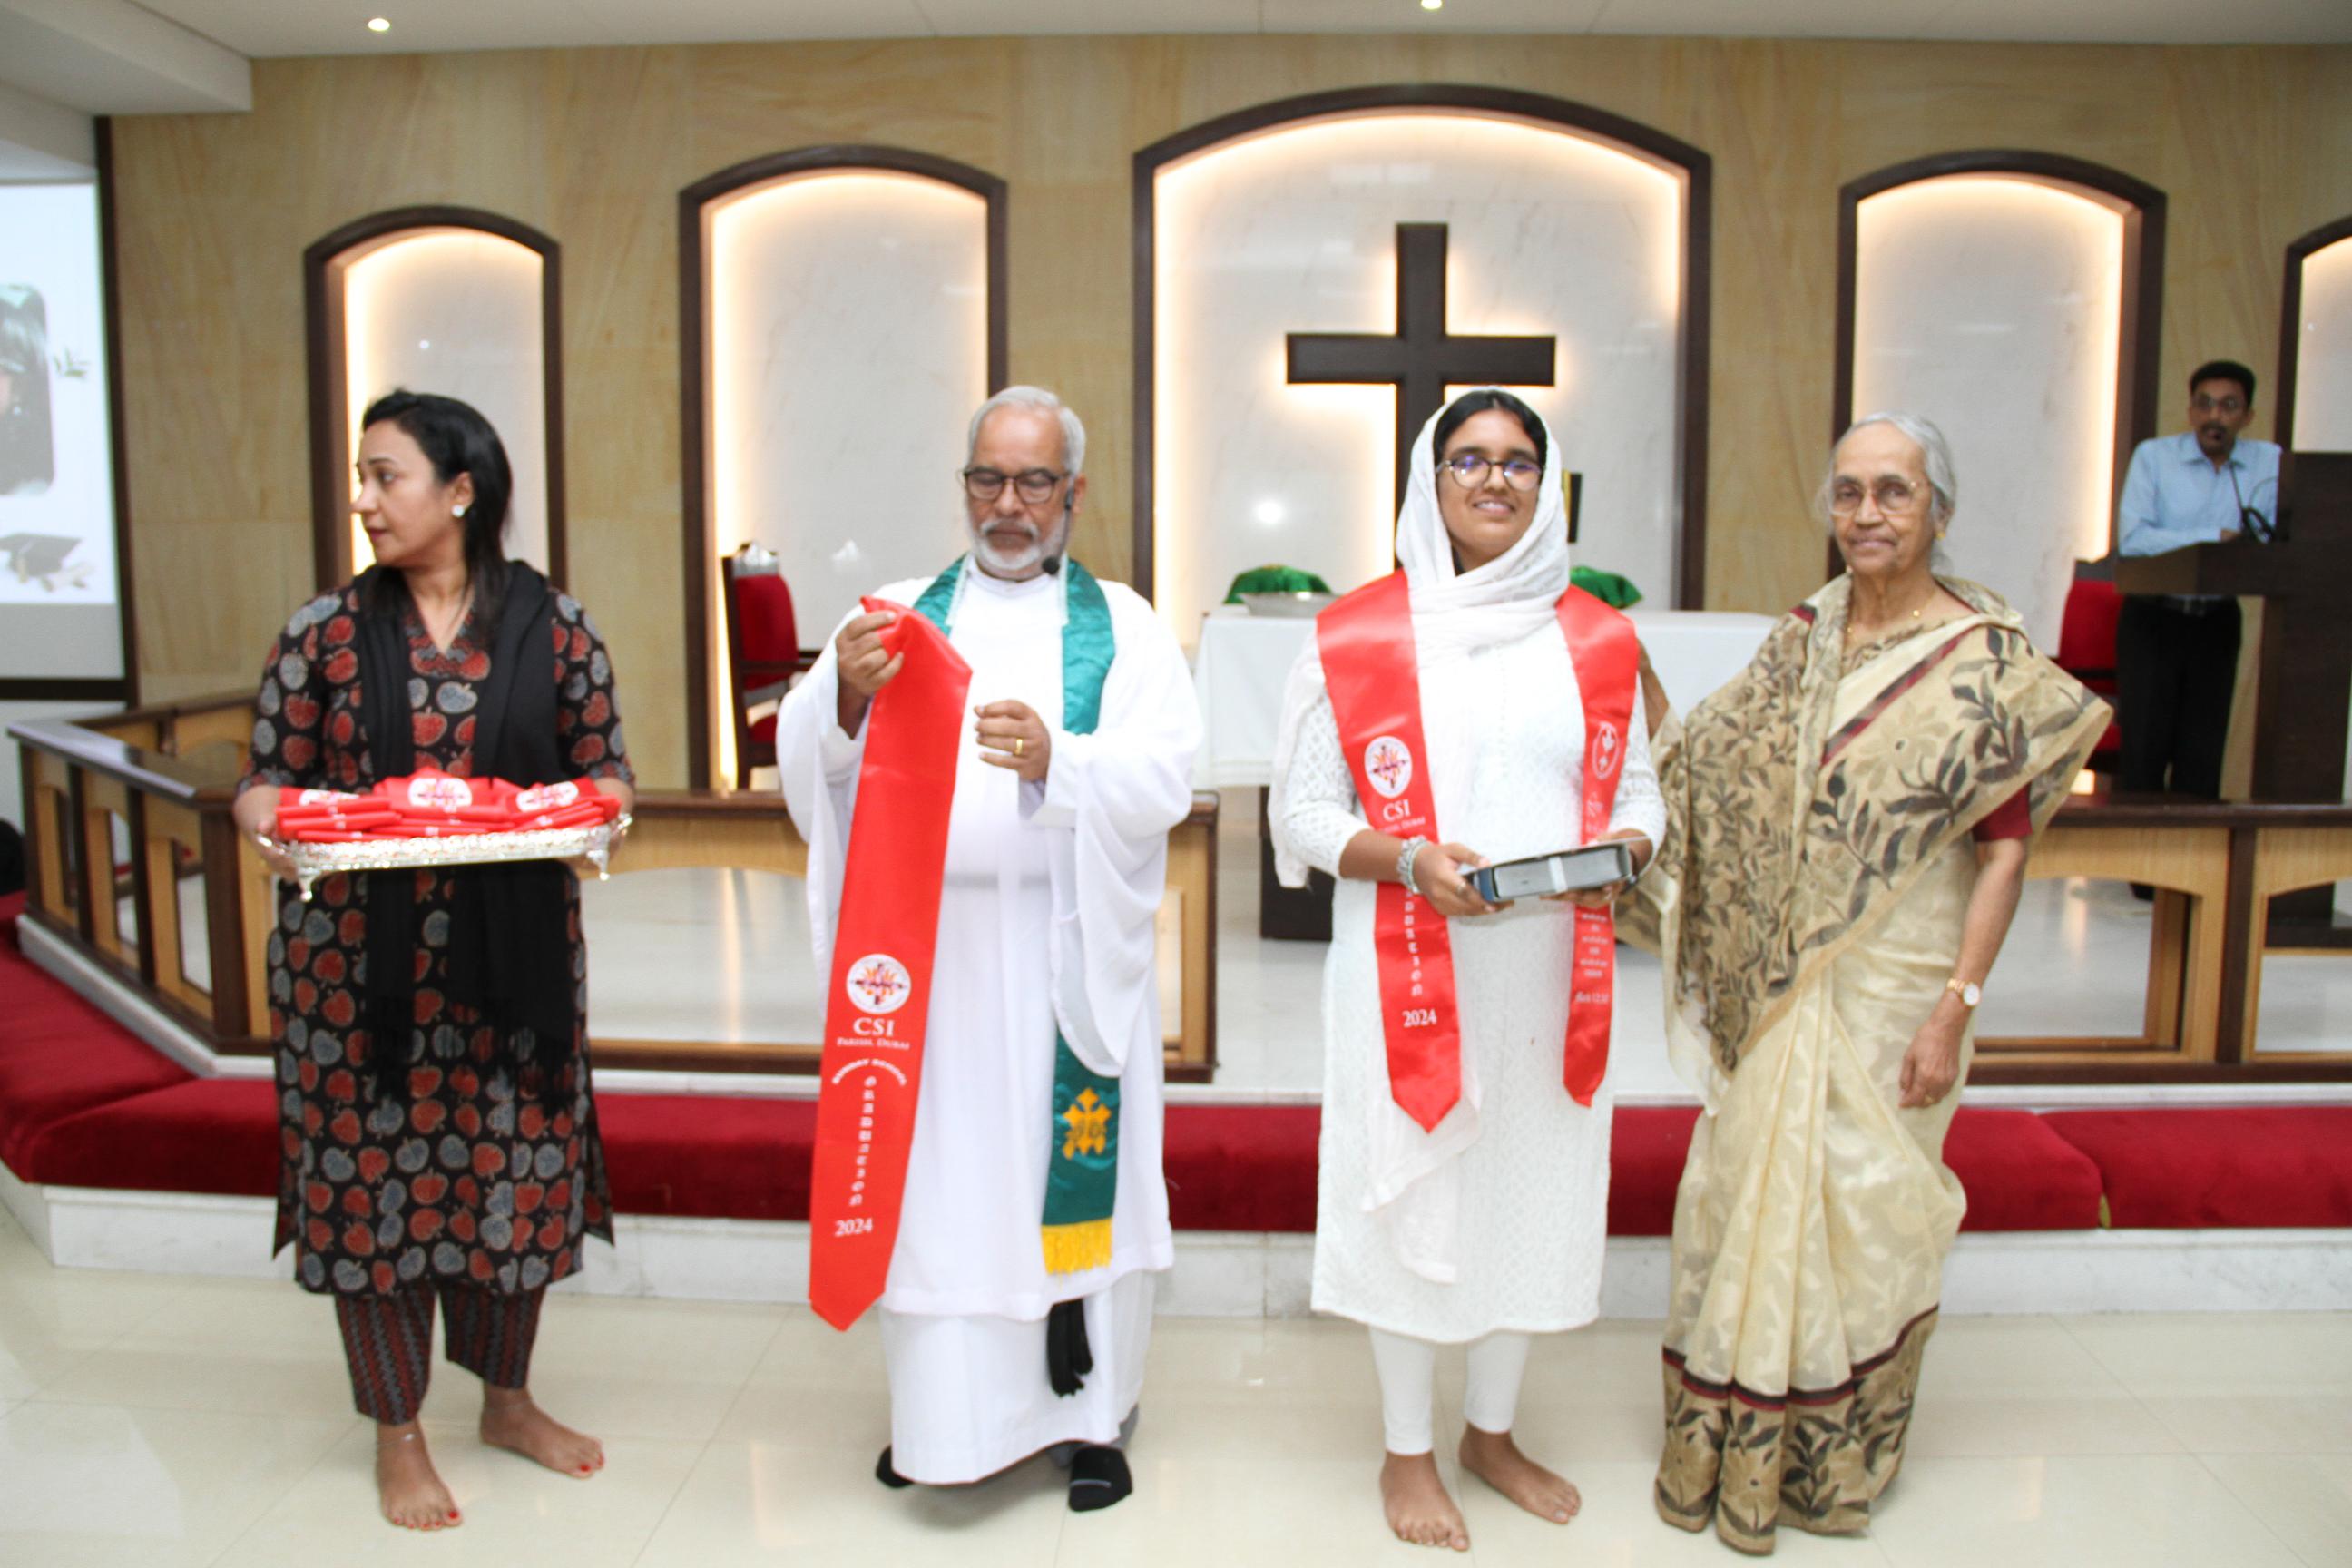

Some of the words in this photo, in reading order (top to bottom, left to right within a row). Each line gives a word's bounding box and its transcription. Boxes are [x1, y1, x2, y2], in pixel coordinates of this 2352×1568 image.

[1383, 799, 1411, 822] CSI
[853, 1017, 895, 1037] CSI
[1402, 1009, 1437, 1029] 2024
[834, 1218, 873, 1238] 2024
